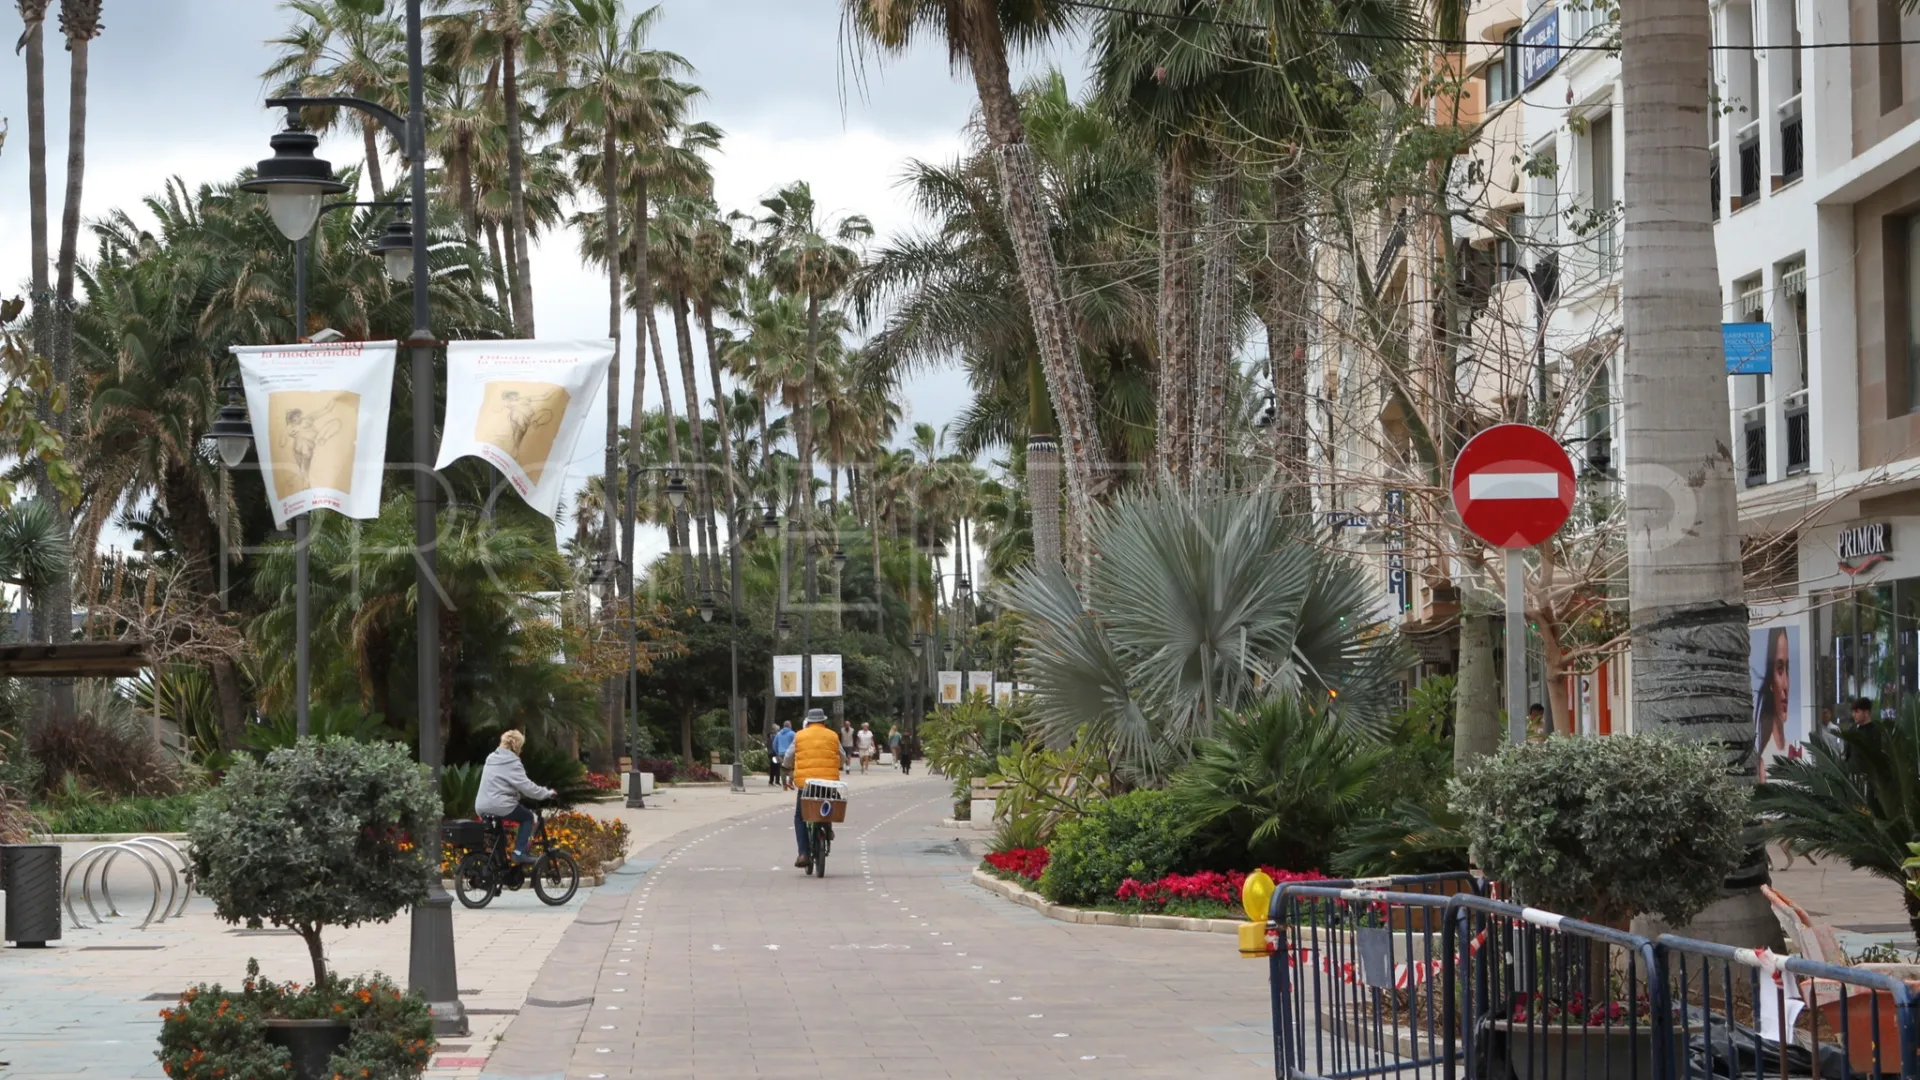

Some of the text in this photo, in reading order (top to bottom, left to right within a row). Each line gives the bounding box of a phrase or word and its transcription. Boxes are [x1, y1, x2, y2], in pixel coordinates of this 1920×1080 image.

[260, 347, 361, 358] la modernidad
[311, 498, 341, 509] MAPFRE
[1837, 522, 1885, 559] PRIMOR
[1389, 492, 1404, 614] FARMACI
